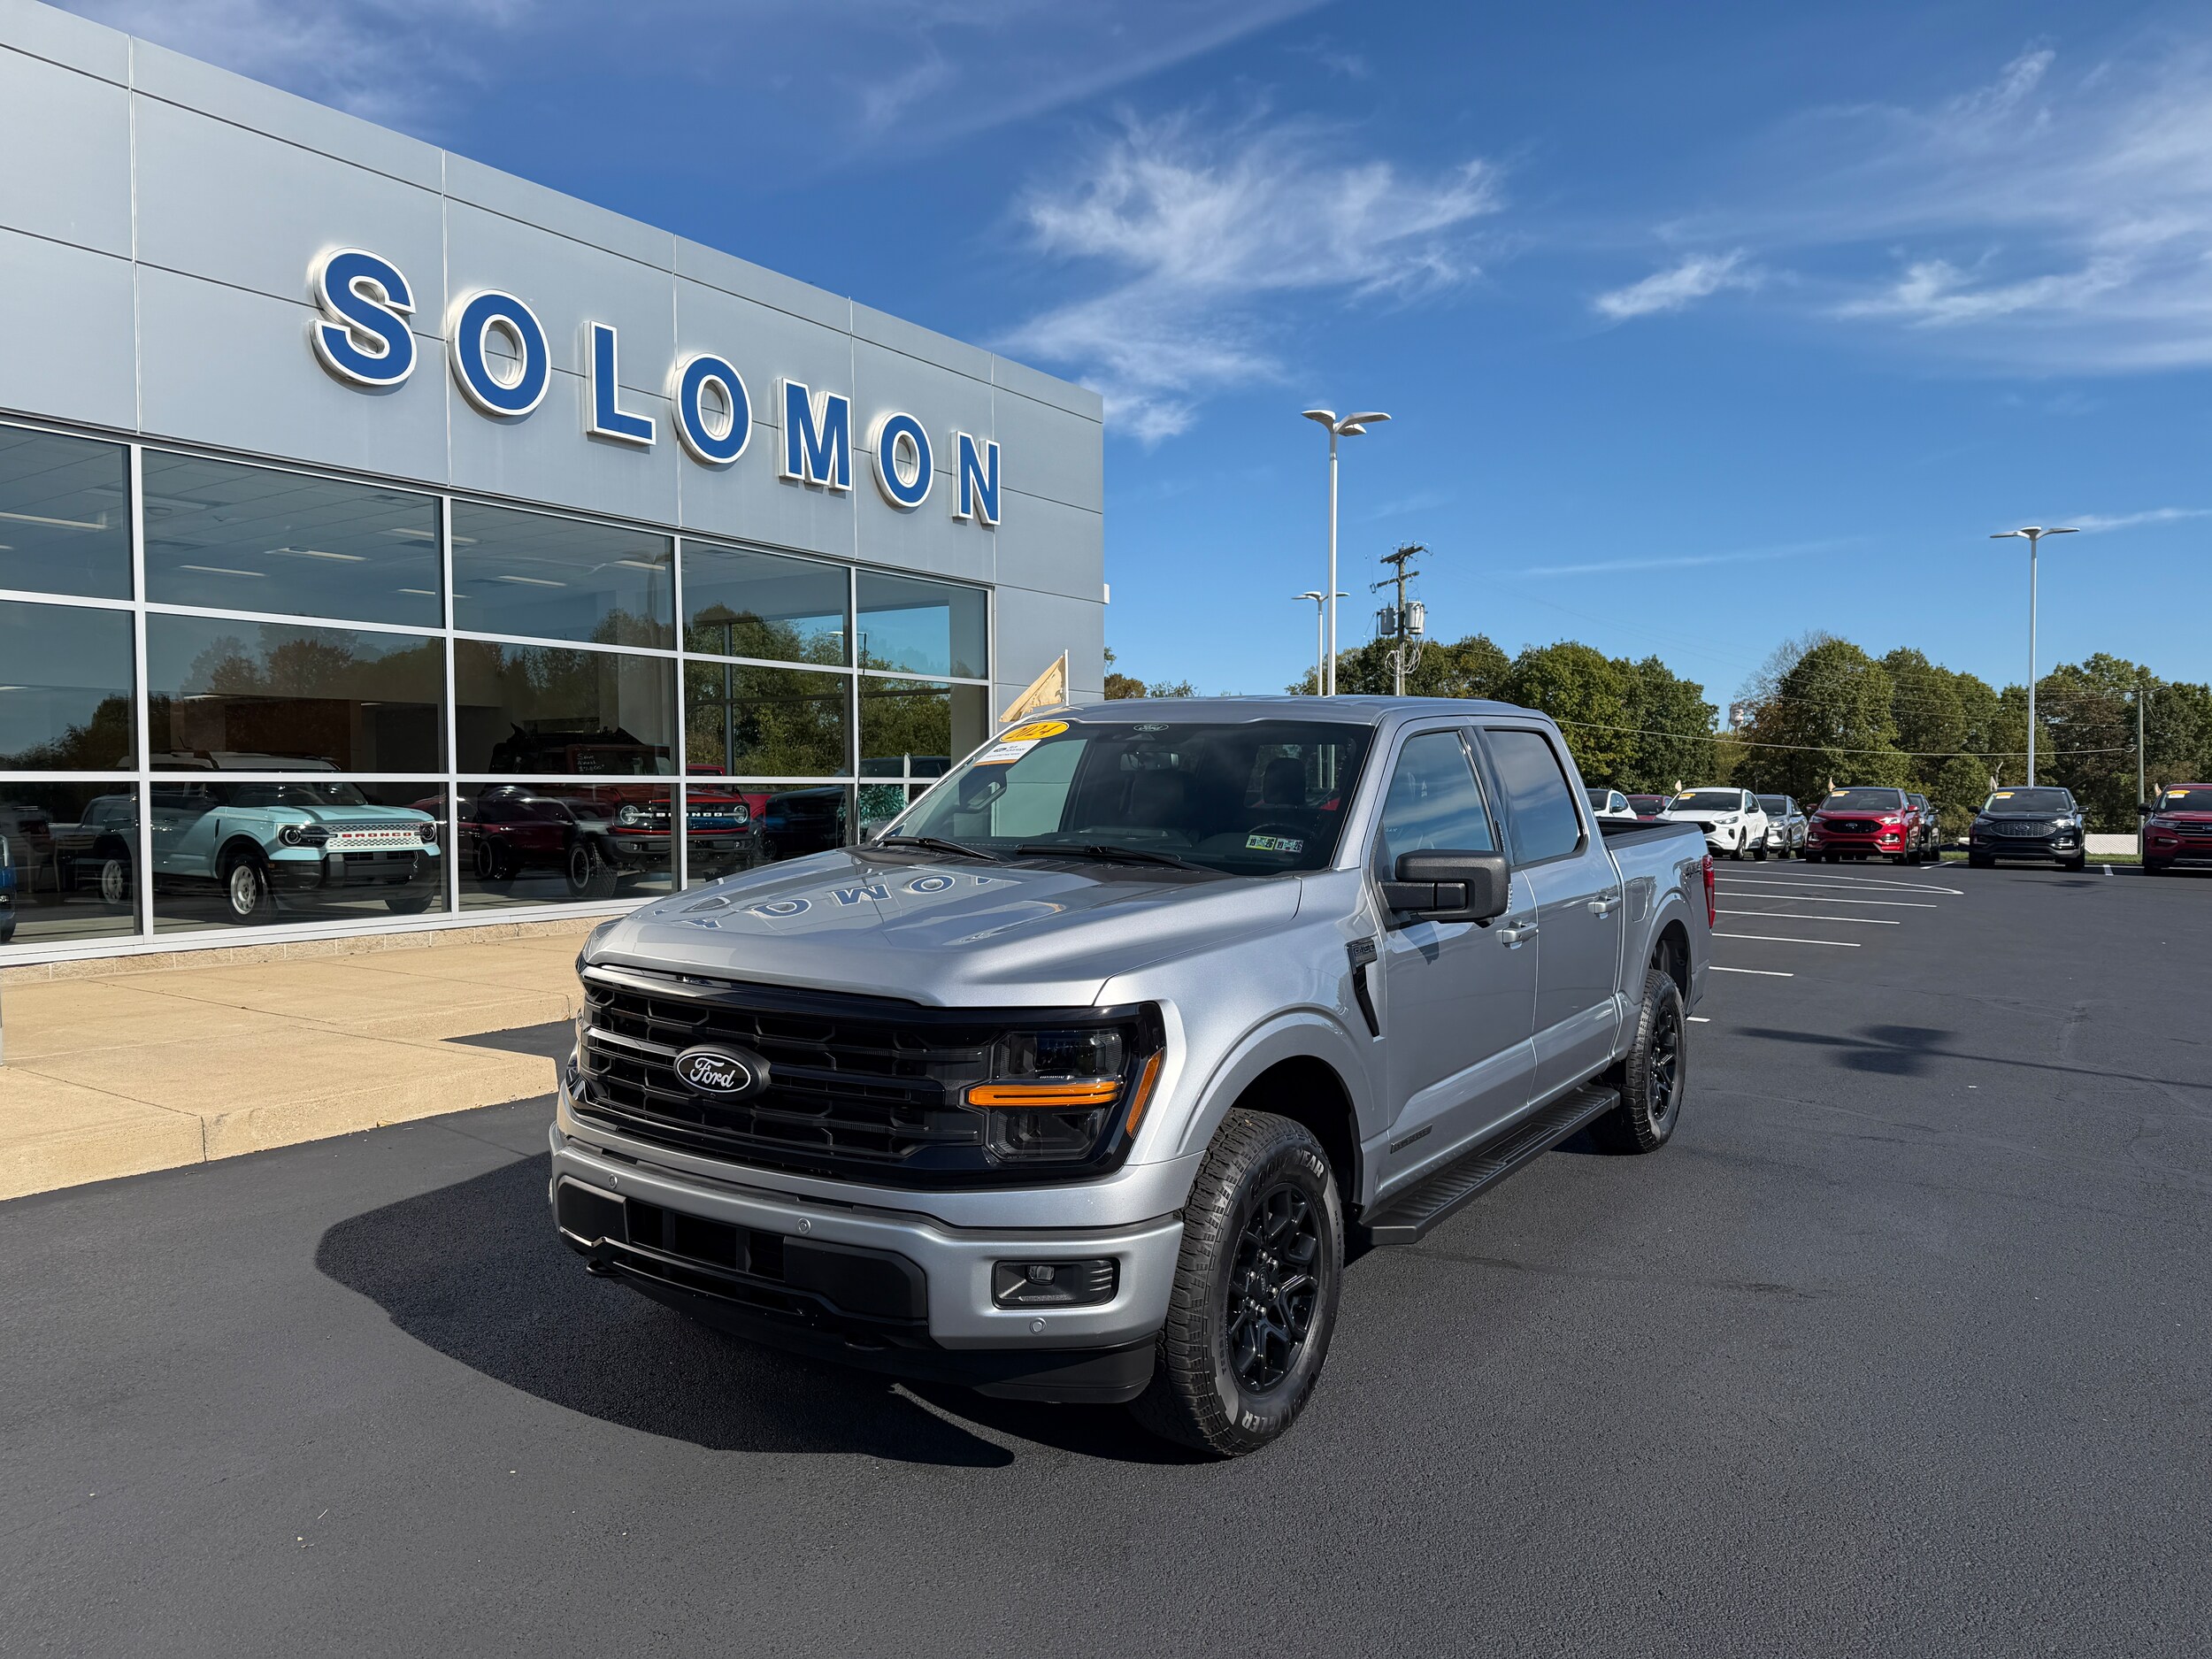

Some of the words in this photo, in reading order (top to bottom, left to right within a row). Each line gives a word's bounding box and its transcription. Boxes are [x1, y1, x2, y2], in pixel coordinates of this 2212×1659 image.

[308, 247, 1002, 526] SOLOMON
[1003, 723, 1064, 740] 2024
[690, 1057, 736, 1087] Ford
